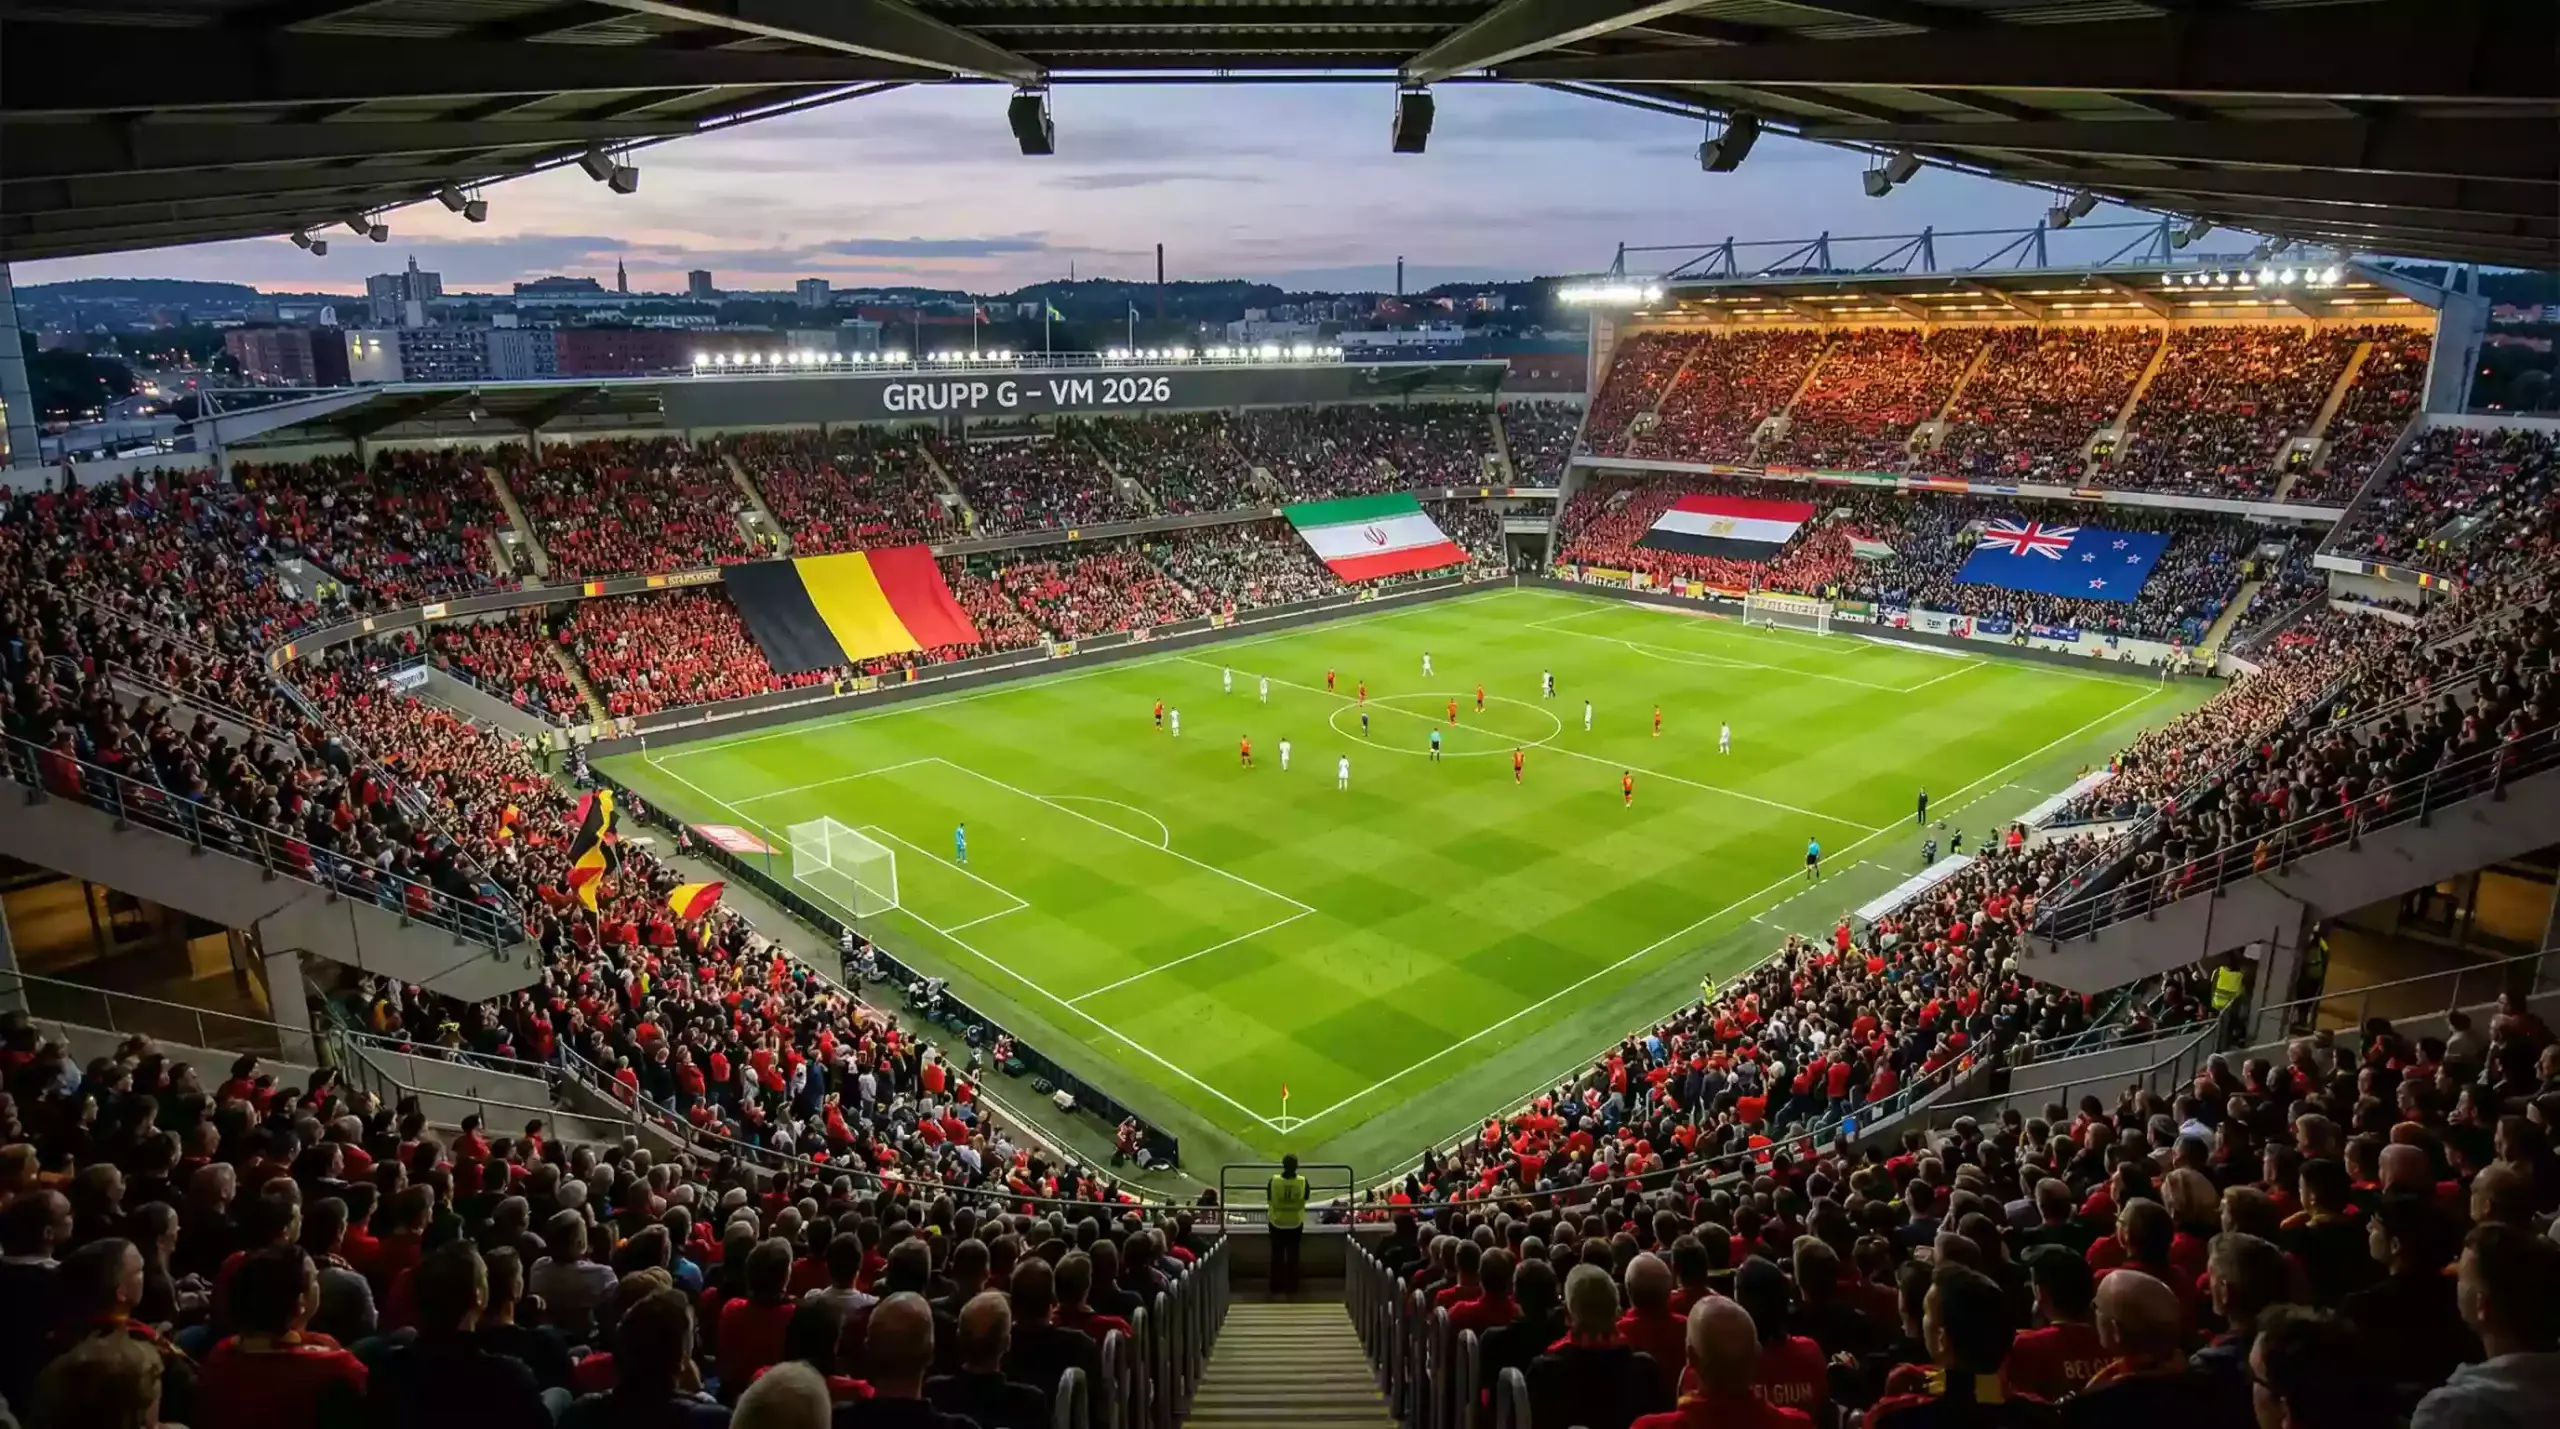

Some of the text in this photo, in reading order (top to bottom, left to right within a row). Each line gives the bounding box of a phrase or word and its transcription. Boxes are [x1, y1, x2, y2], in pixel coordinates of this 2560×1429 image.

[883, 382, 989, 410] GRUPP
[997, 380, 1018, 406] G
[1050, 378, 1093, 405] VM
[1102, 376, 1171, 403] 2026
